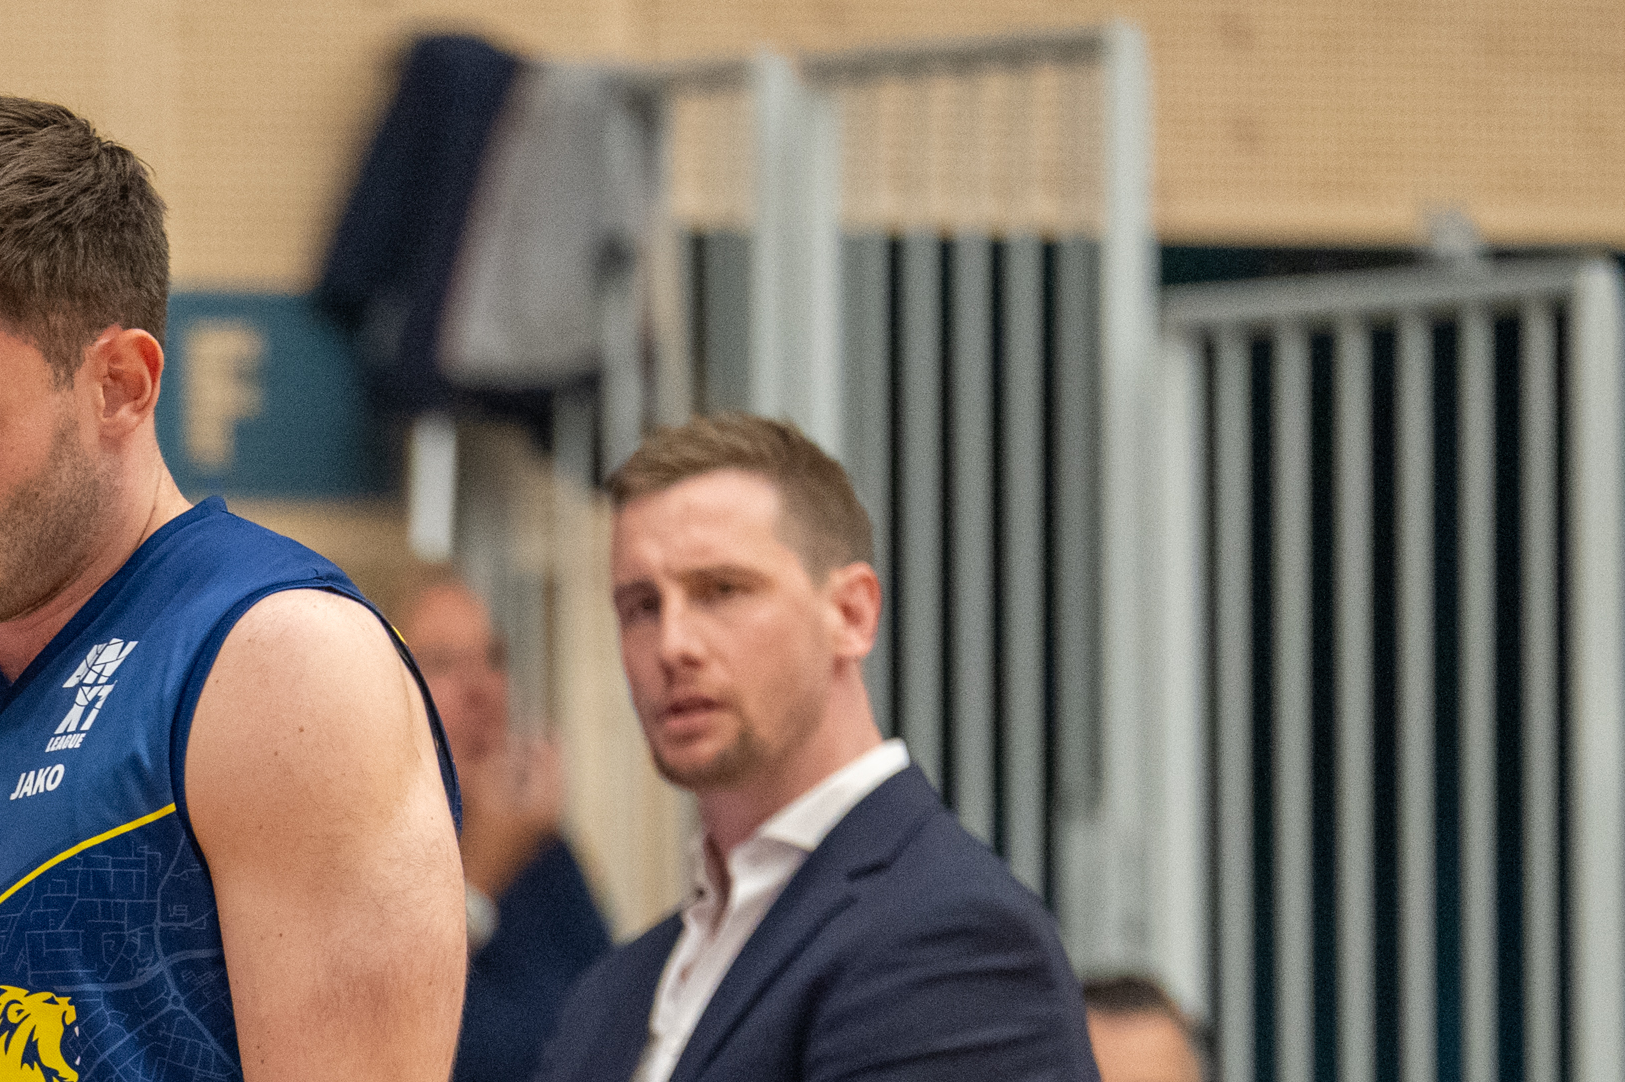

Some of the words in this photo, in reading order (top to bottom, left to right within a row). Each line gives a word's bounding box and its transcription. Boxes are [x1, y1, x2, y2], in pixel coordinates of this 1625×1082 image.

[181, 321, 264, 468] F
[45, 733, 86, 752] LEAGUE
[10, 764, 65, 800] JAKO
